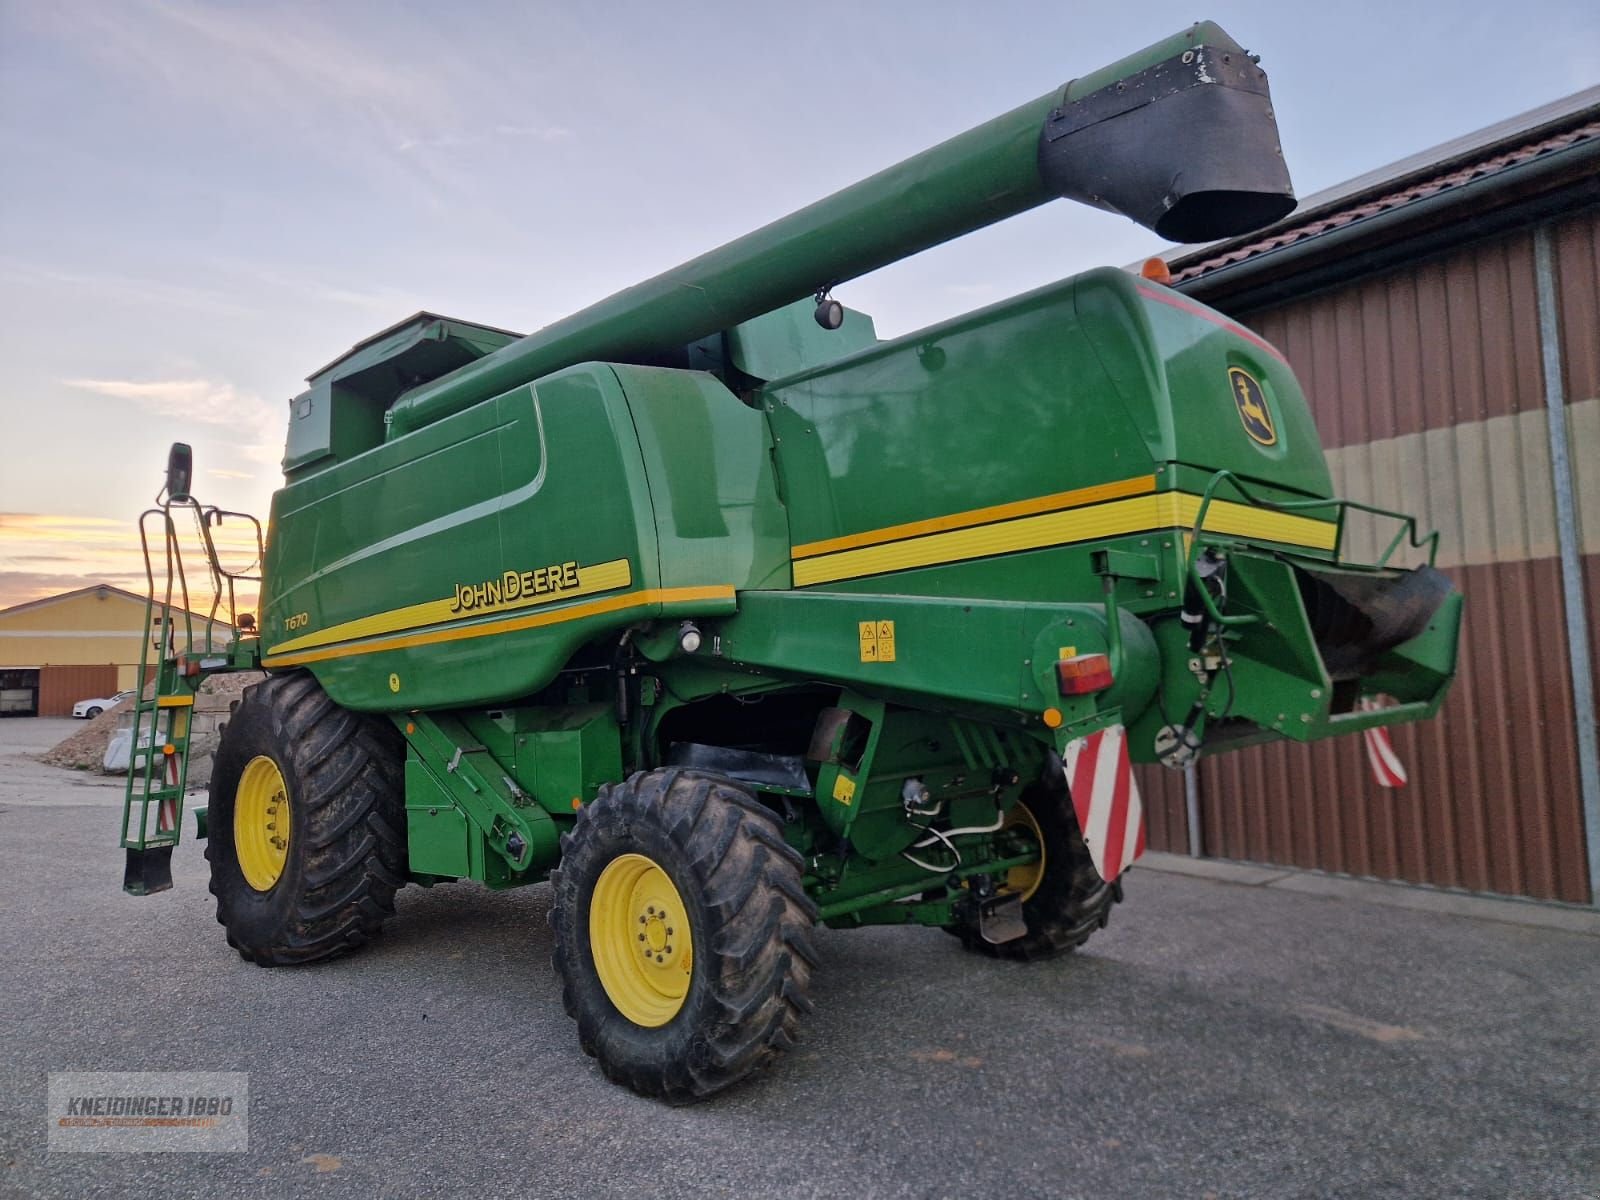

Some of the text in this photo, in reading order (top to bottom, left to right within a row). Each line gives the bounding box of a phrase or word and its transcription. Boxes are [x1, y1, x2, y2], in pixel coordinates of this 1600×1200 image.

[451, 561, 579, 612] JOHN DEERE
[284, 612, 308, 631] T670
